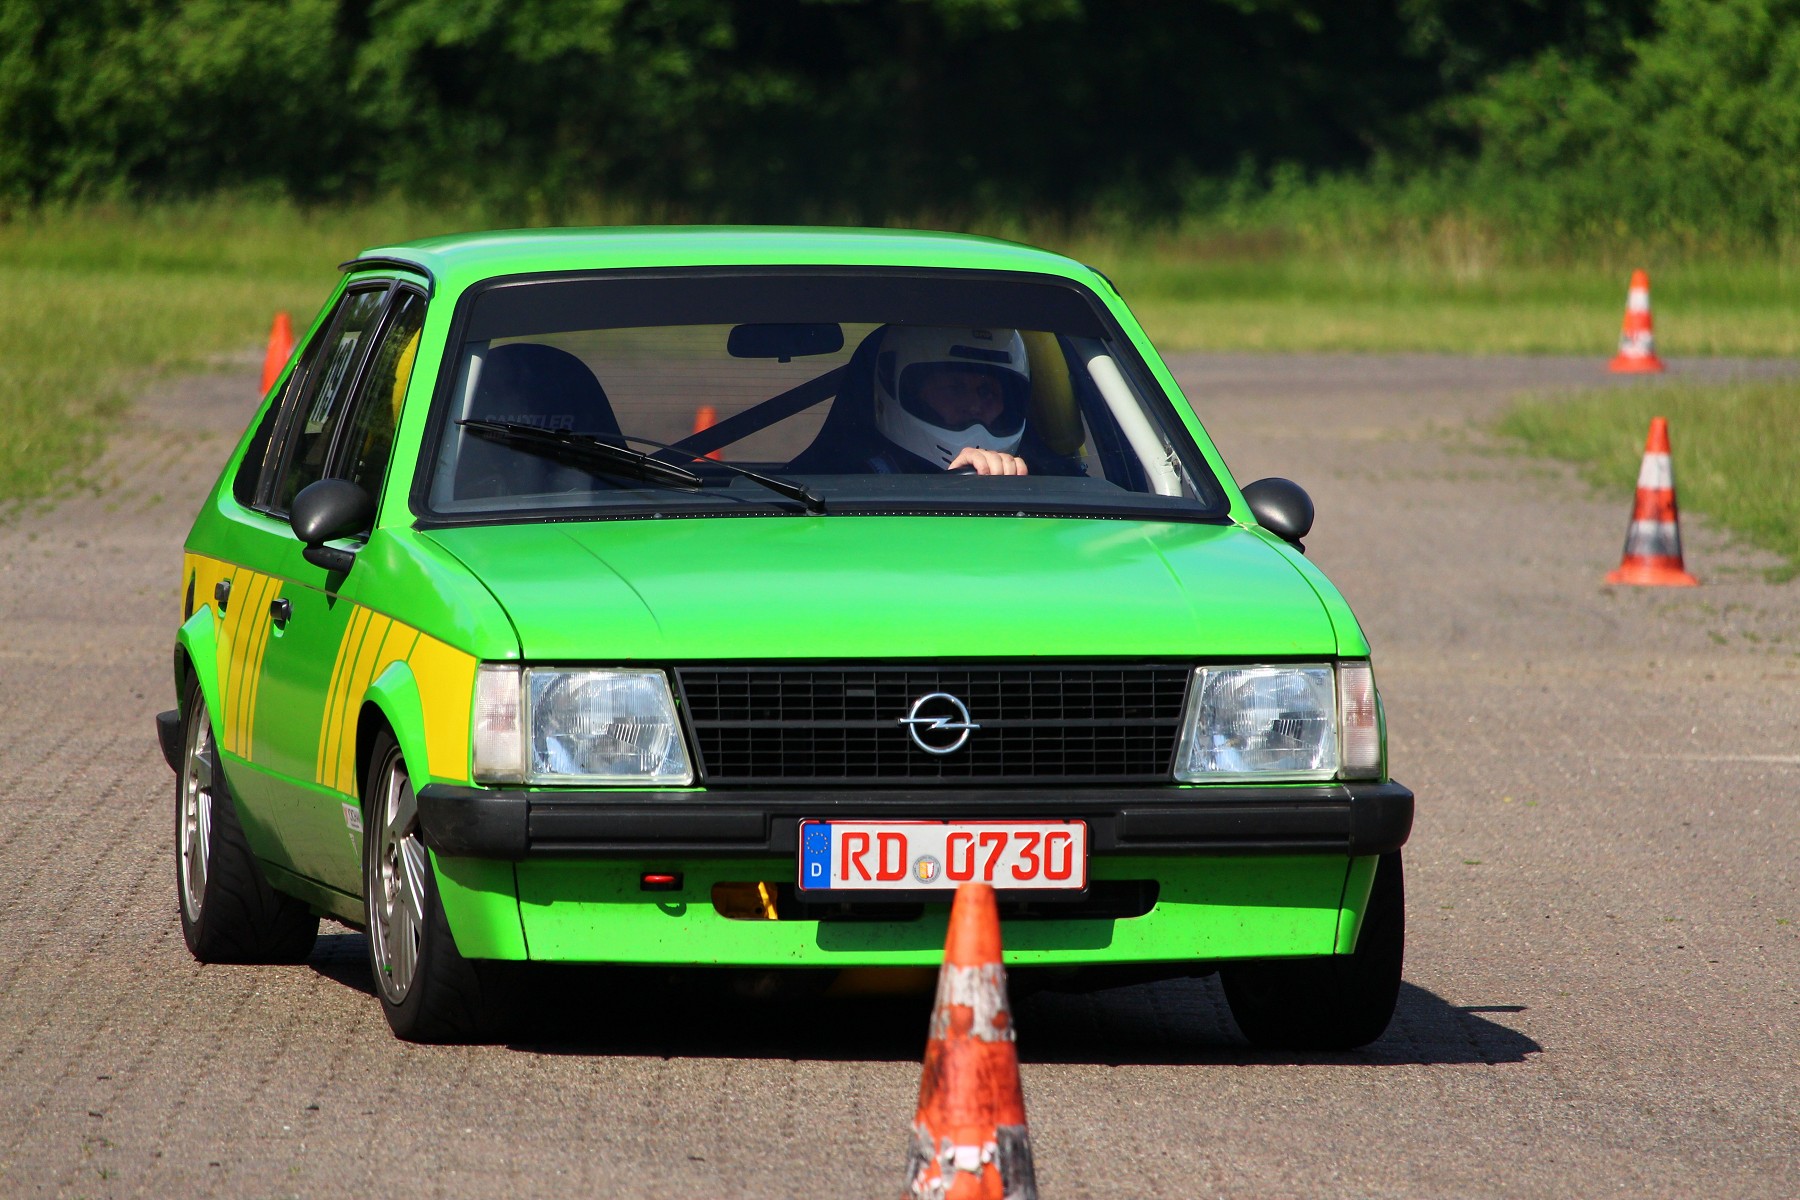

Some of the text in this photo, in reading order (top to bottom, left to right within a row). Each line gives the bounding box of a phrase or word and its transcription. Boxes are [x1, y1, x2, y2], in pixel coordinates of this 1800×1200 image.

[811, 862, 822, 877] D
[841, 832, 908, 881] RD
[945, 831, 1073, 881] 0730
